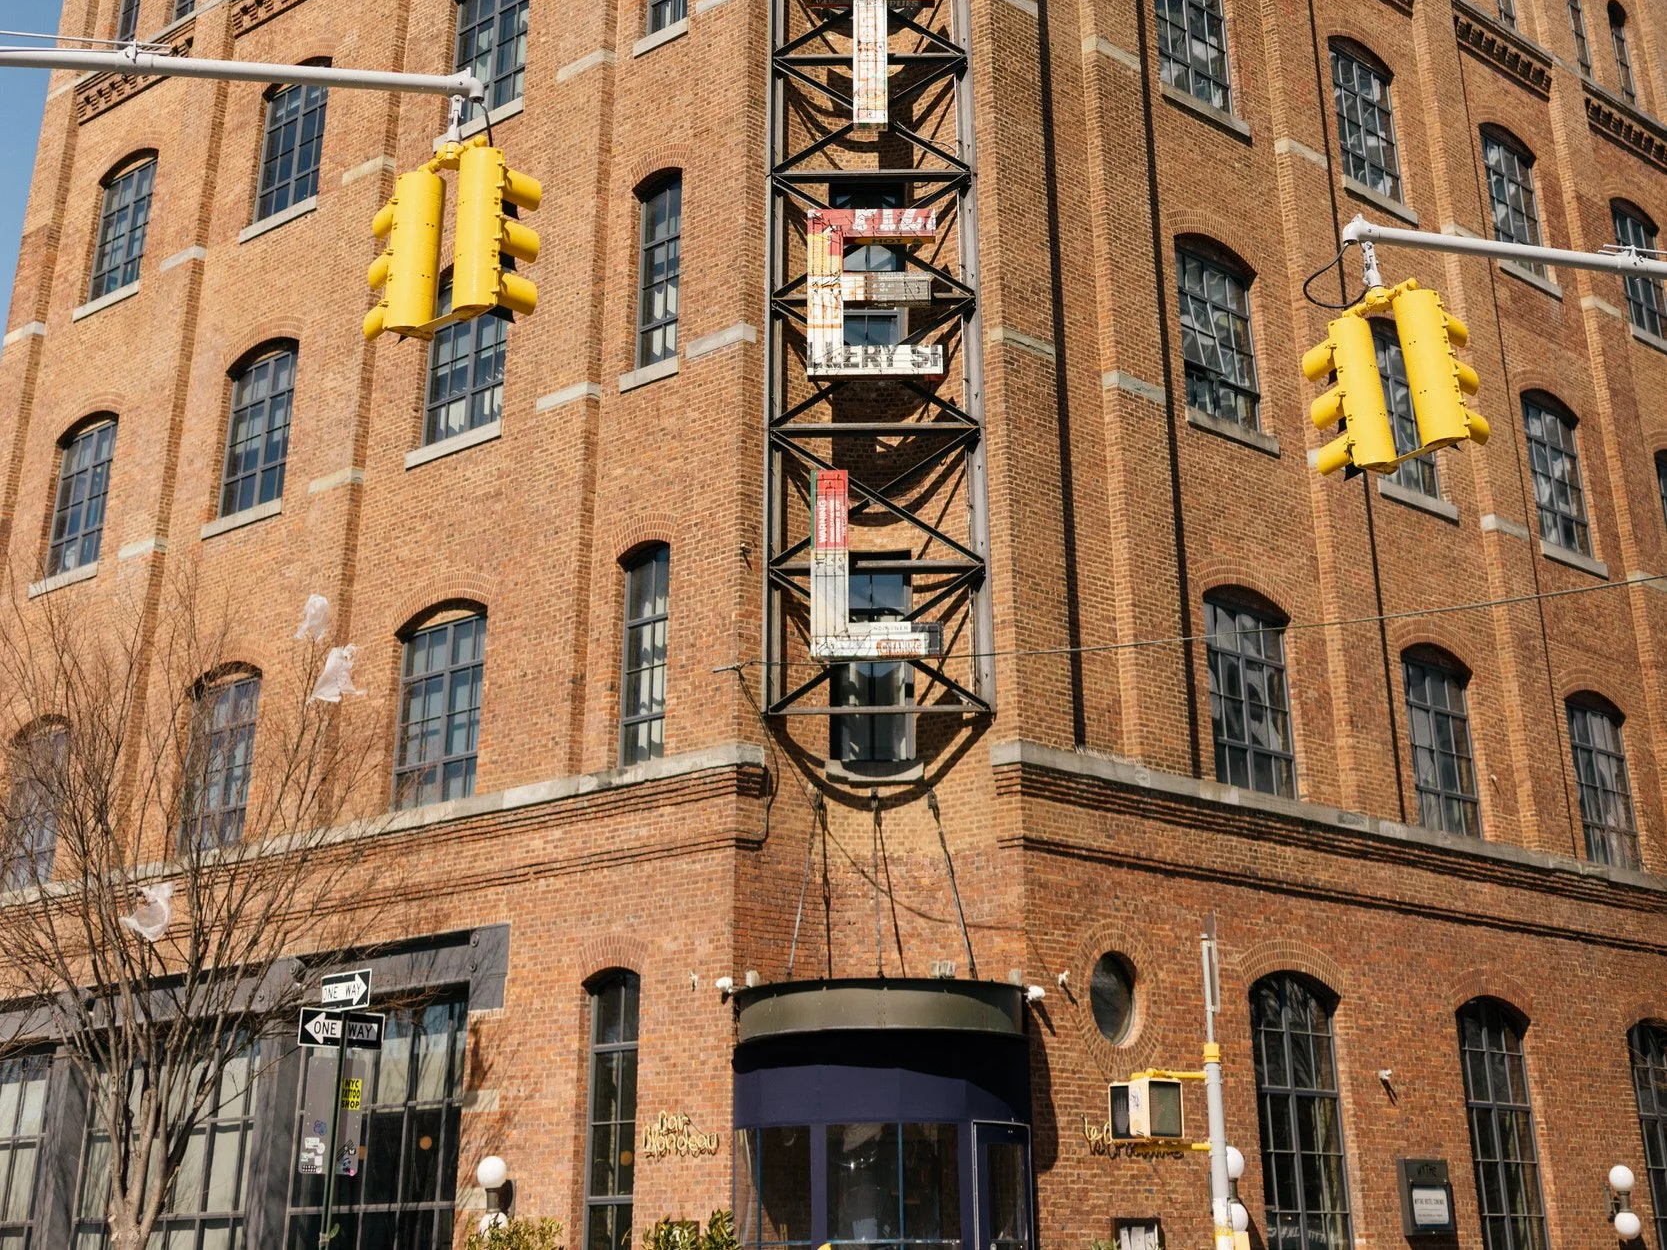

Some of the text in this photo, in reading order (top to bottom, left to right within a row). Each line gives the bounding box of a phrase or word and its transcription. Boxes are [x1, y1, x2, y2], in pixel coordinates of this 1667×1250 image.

[818, 500, 827, 543] WARNING
[322, 982, 362, 1001] ONE WAY
[313, 1021, 373, 1039] ONE WAY
[345, 1080, 360, 1088] NYC
[342, 1089, 361, 1099] TATTOO
[341, 1100, 360, 1109] SHOP
[658, 1110, 689, 1133] Bar
